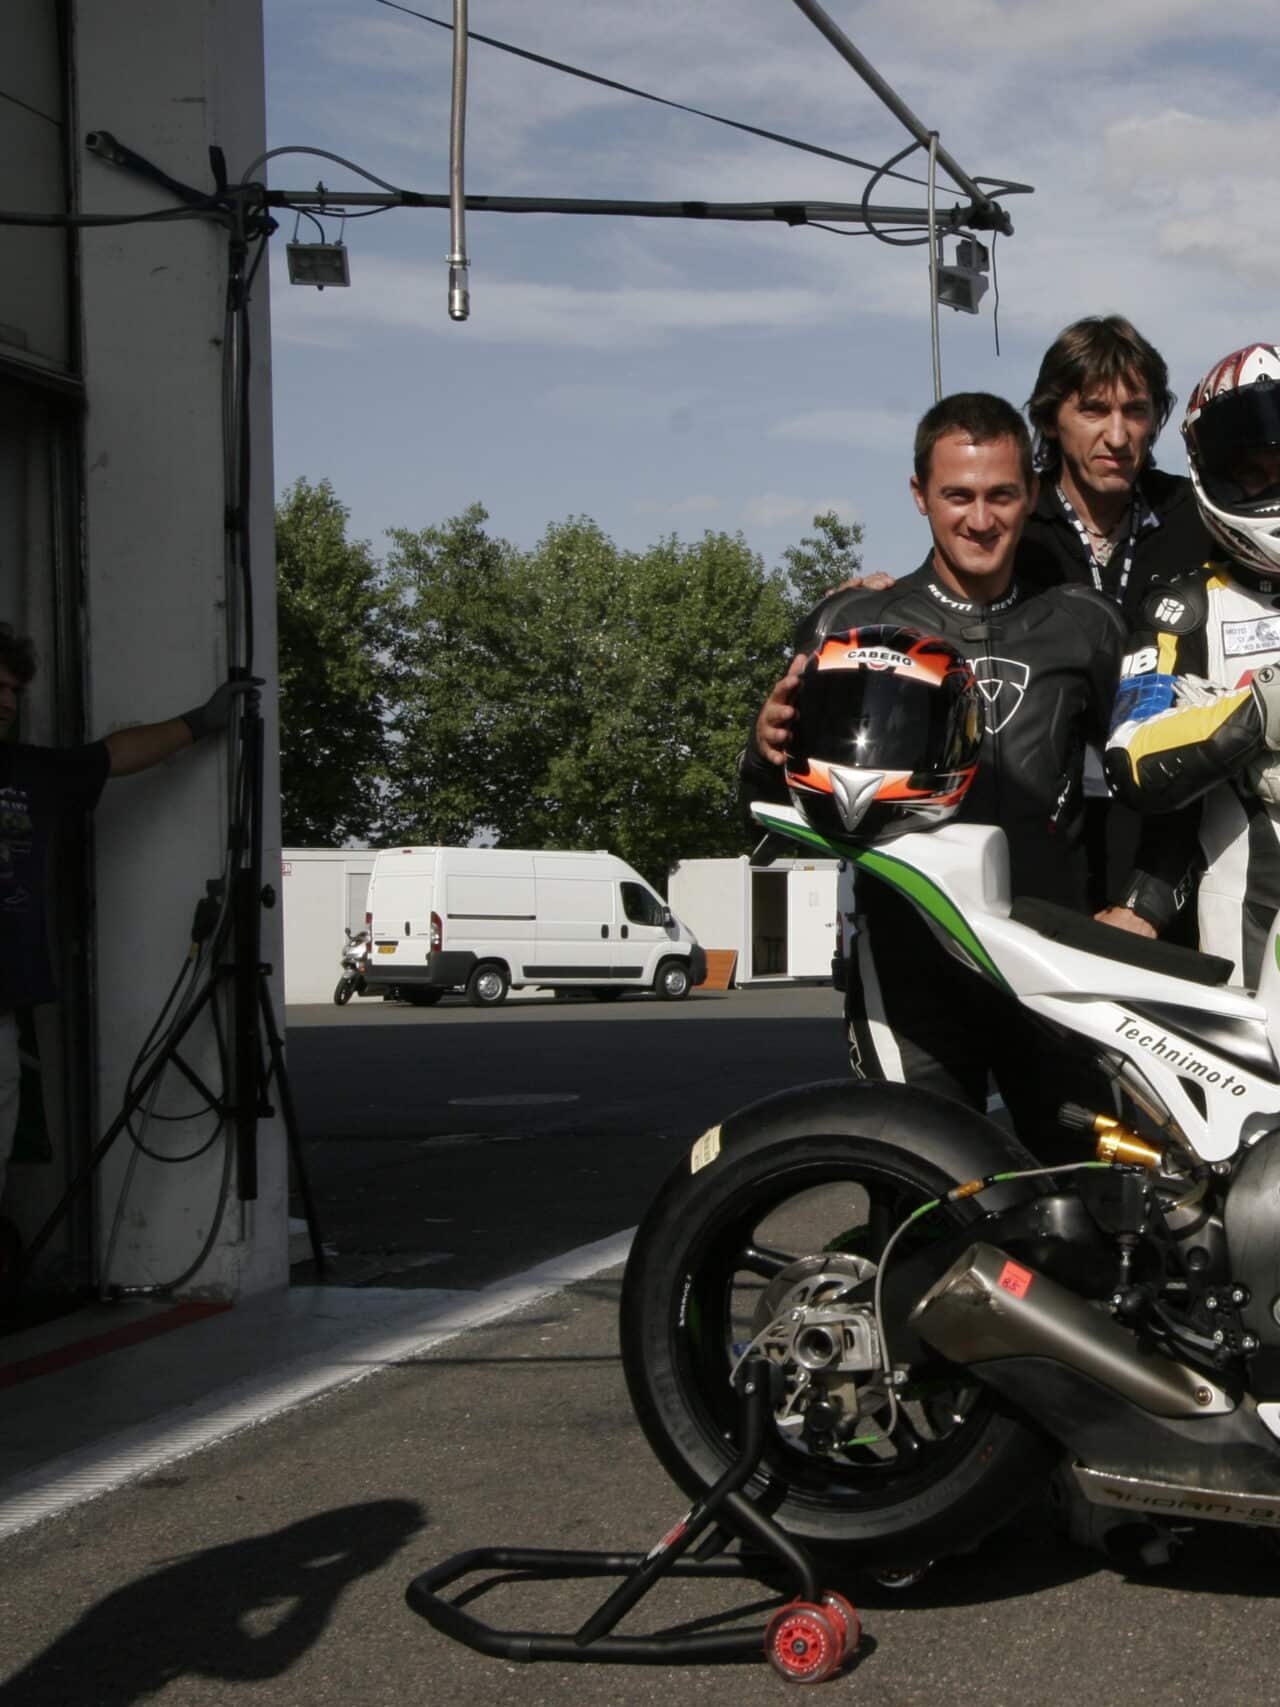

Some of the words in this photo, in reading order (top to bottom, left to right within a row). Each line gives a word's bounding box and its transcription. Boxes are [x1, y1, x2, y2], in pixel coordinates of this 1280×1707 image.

[847, 650, 913, 667] CABERG
[1121, 646, 1158, 678] IB
[1115, 1016, 1247, 1097] Technimoto
